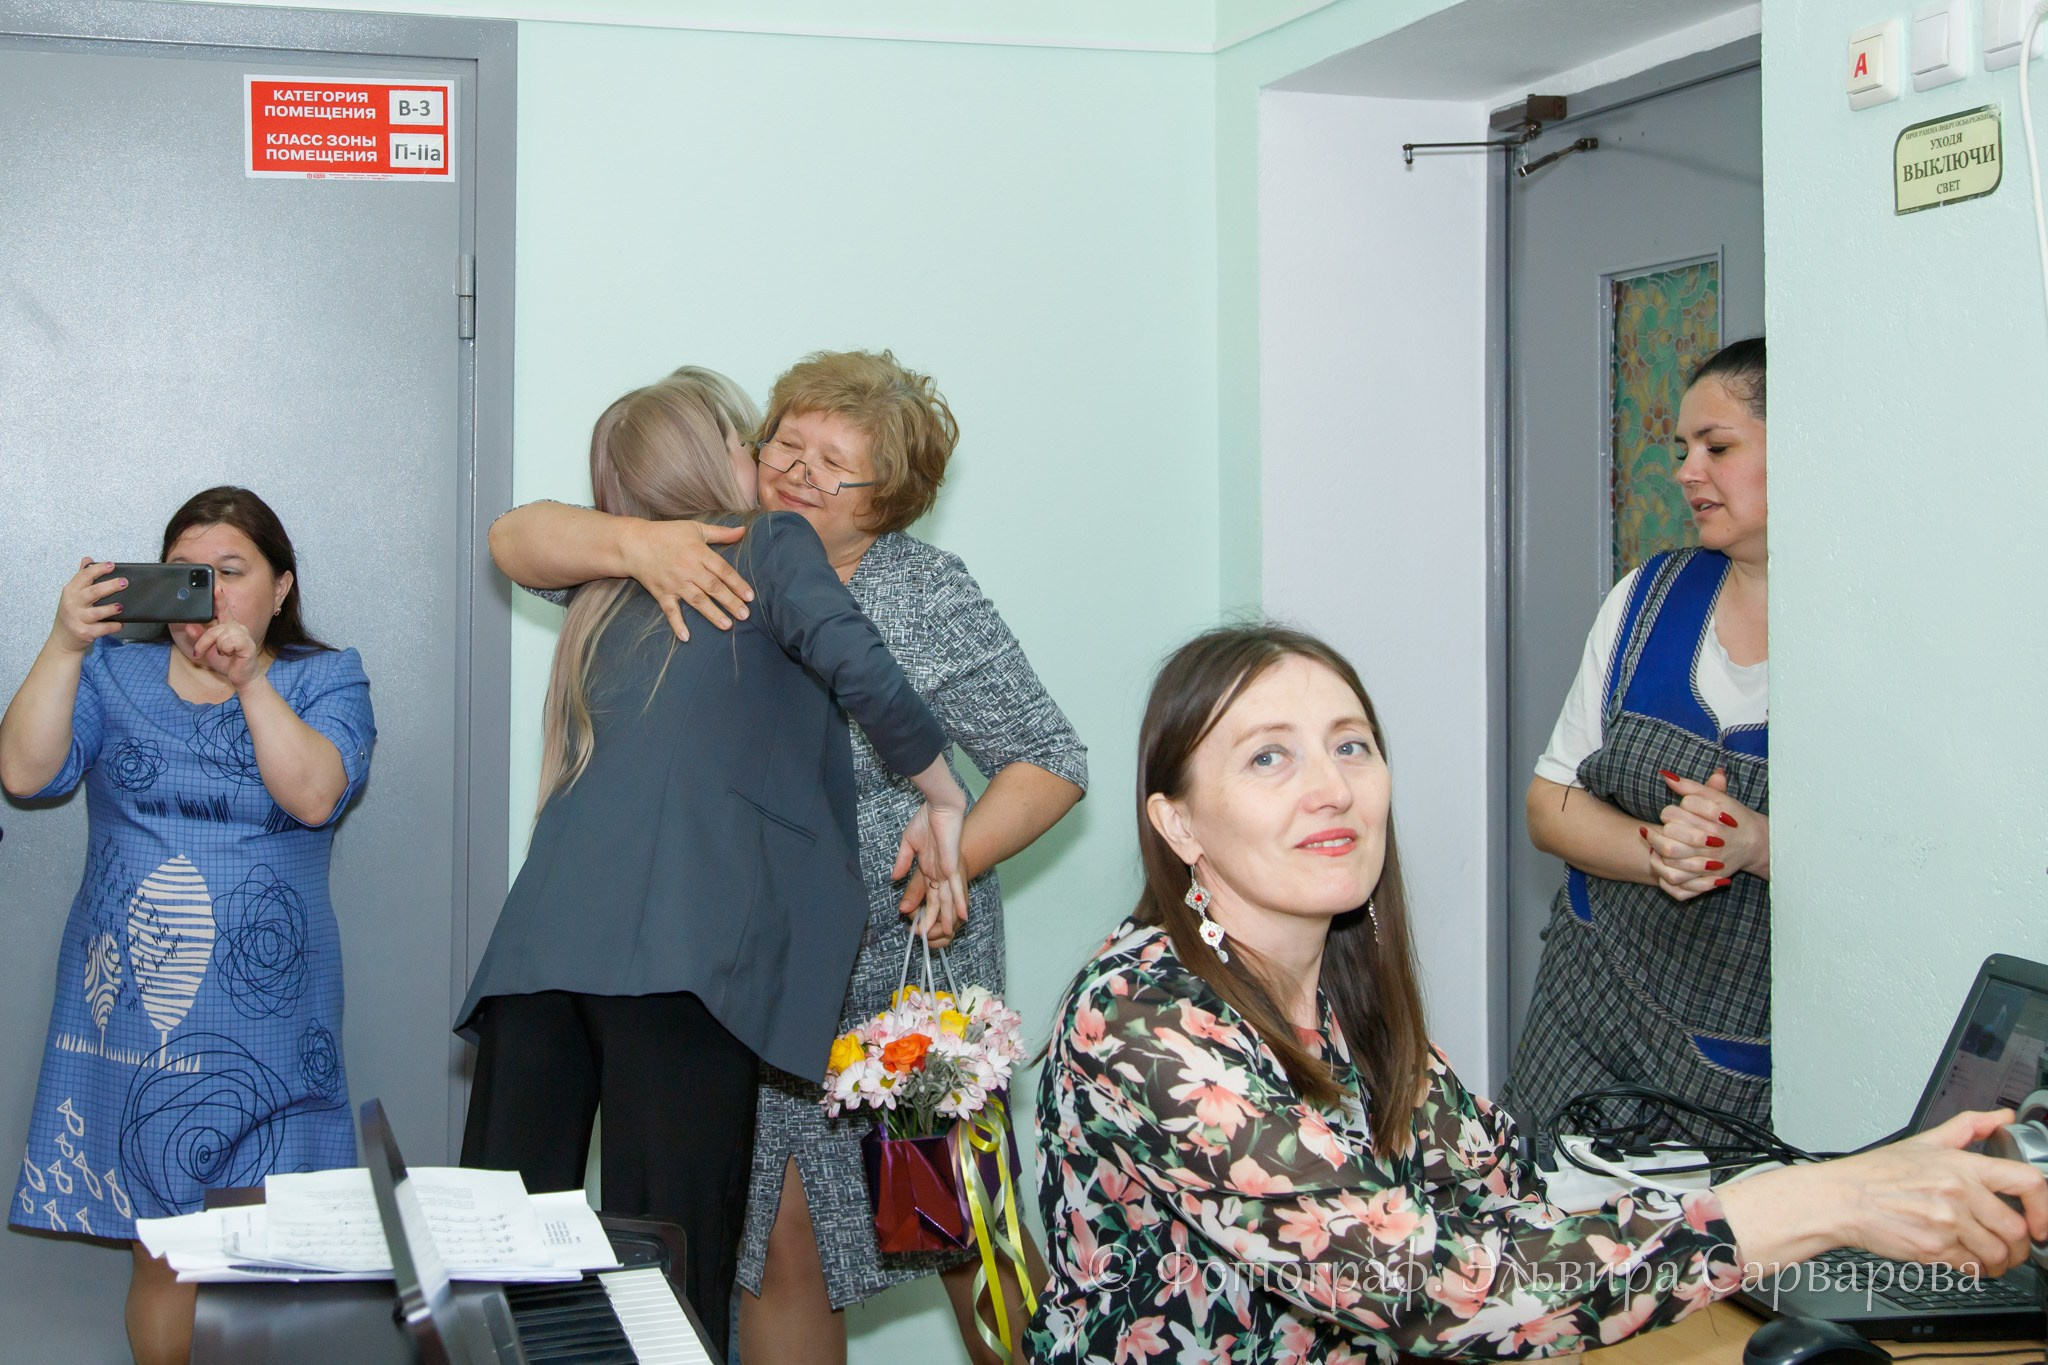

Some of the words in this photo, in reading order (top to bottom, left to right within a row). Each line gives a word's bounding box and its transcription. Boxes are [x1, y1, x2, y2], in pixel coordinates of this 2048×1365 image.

[1853, 52, 1868, 79] А
[273, 89, 369, 103] КАТЕГОРИЯ
[264, 105, 377, 120] ПОМЕЩЕНИЯ
[398, 100, 431, 117] В-3
[266, 133, 323, 146] КЛАСС
[326, 135, 377, 147] ЗОНЫ
[1930, 132, 1963, 150] УХОДЯ
[266, 148, 378, 163] ПОМЕЩЕНИЯ
[1902, 144, 1996, 182] ВЫКЛЮЧИ
[1936, 180, 1961, 195] СВЕТ
